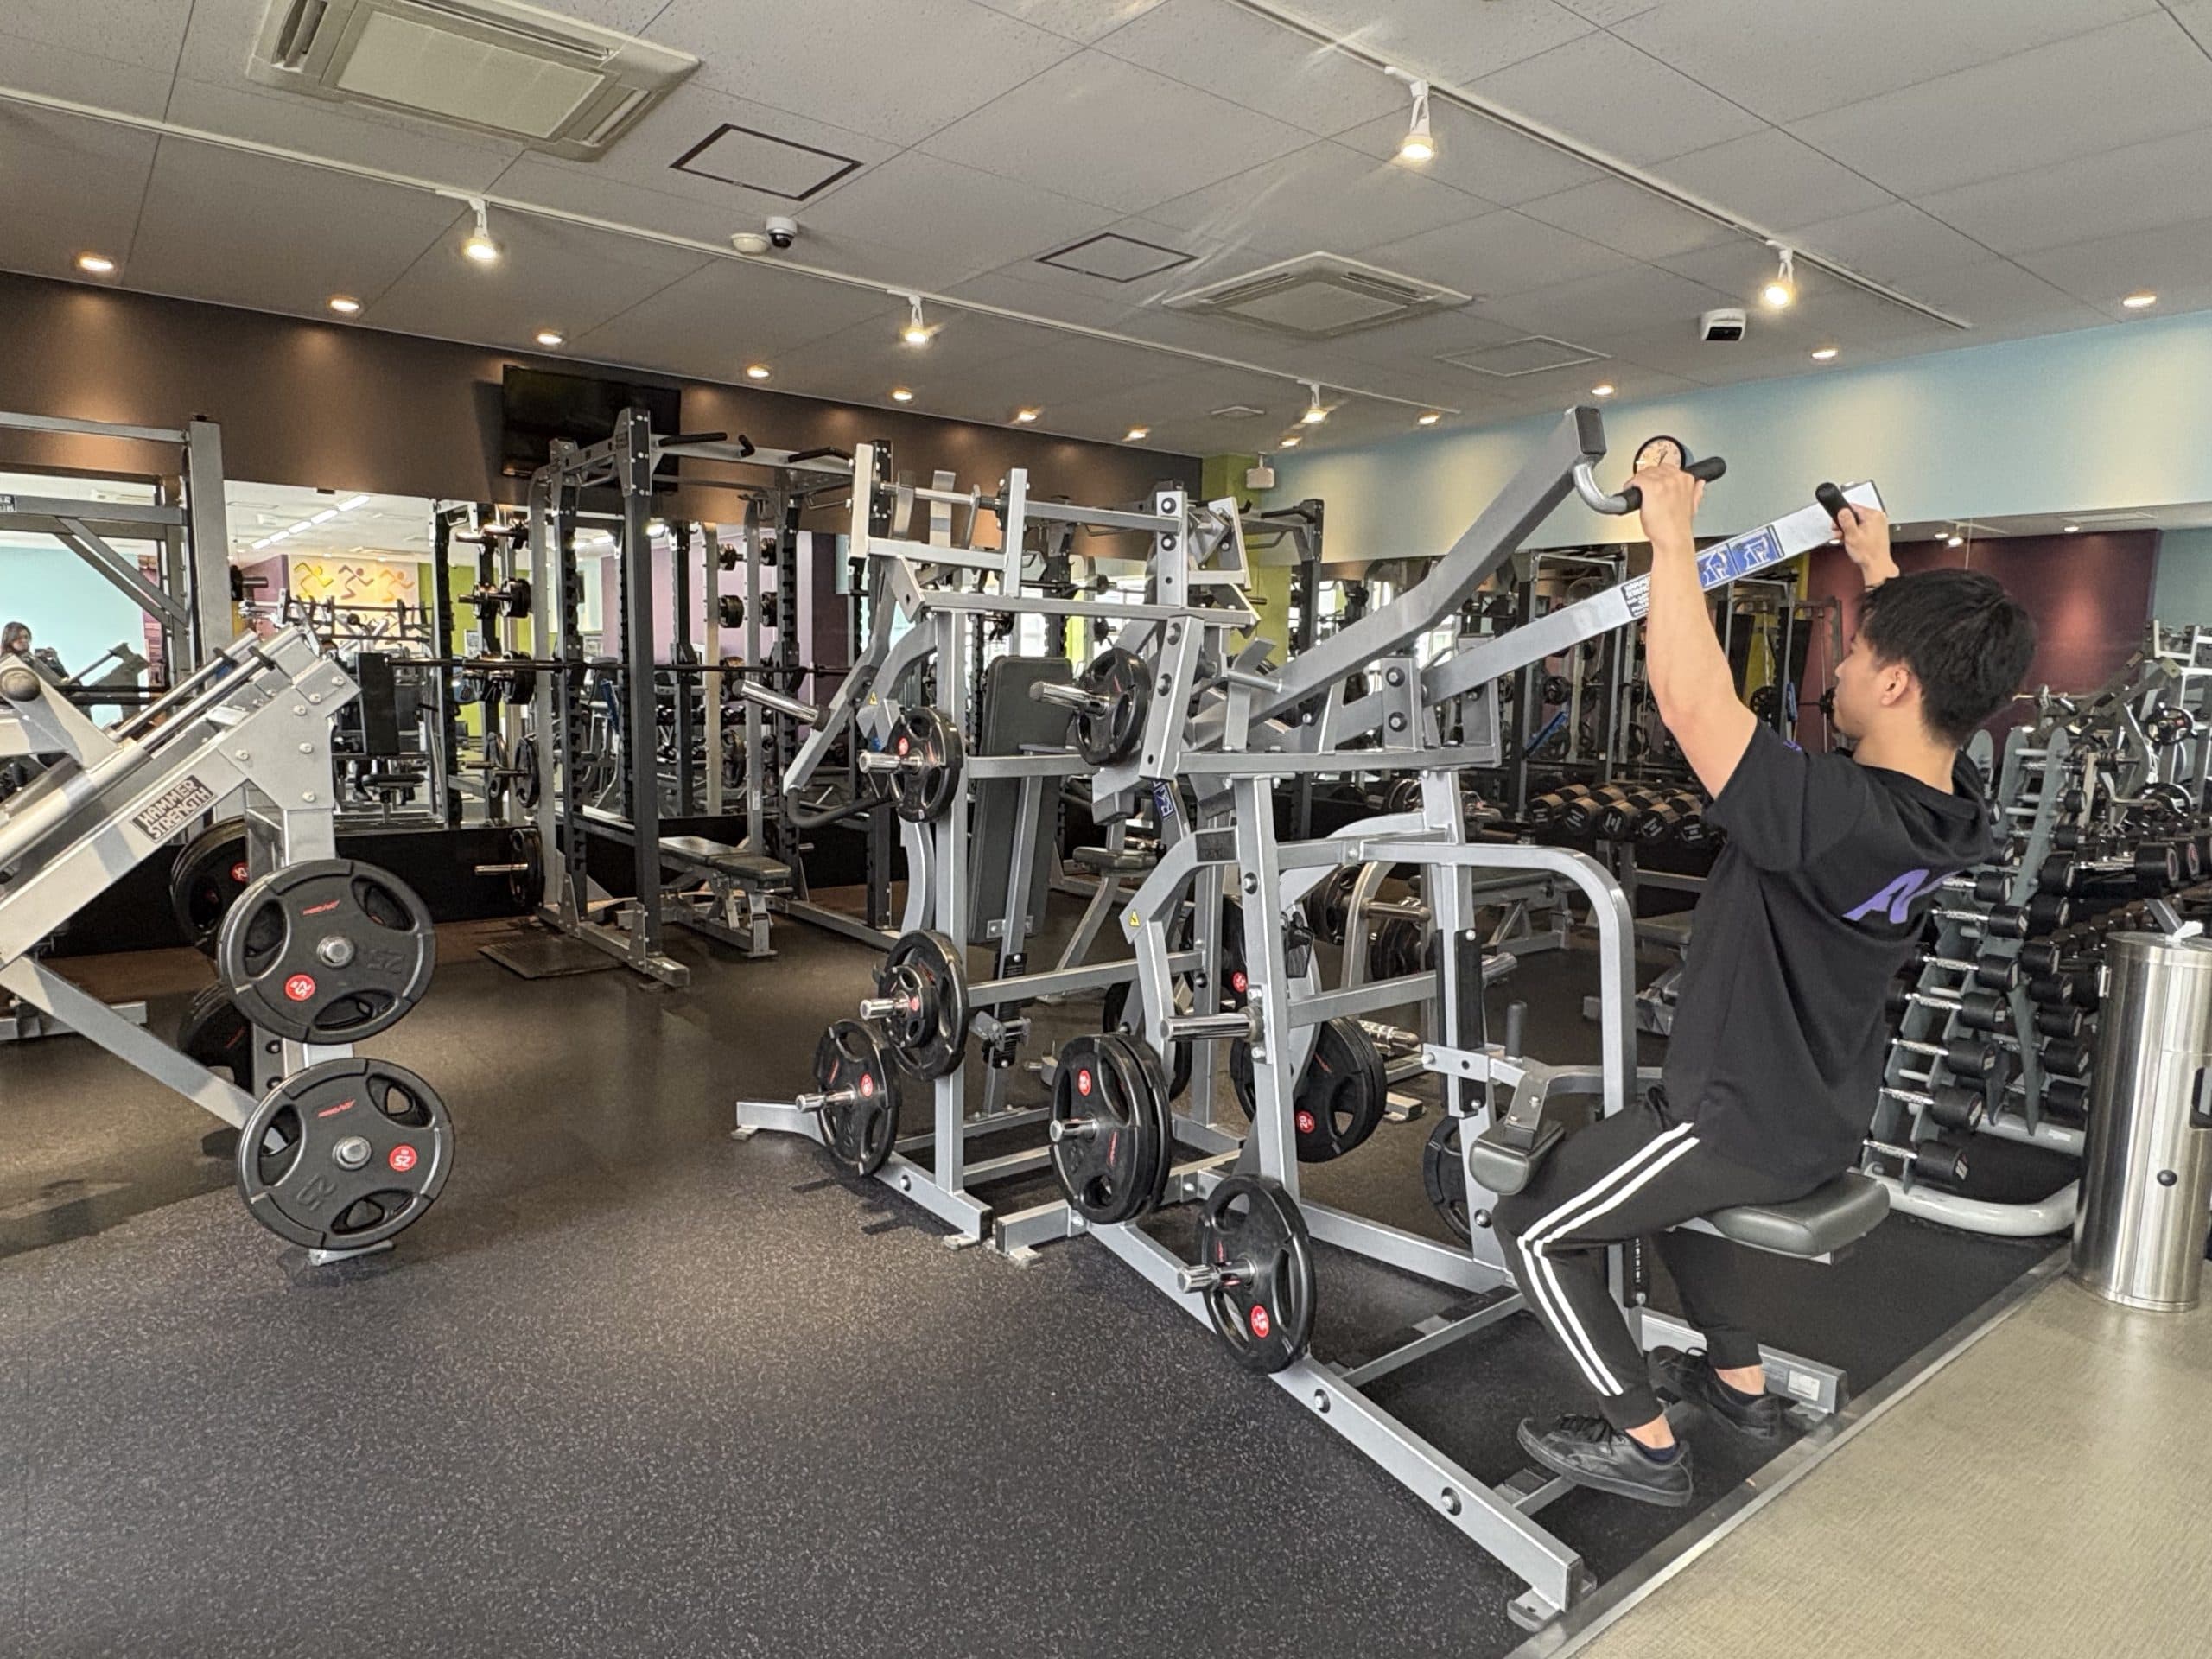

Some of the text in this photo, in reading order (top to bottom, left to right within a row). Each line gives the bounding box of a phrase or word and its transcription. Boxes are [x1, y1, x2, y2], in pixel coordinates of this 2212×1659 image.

[137, 779, 198, 826] HAMMER
[148, 785, 212, 838] STRENGTH
[295, 980, 312, 996] 25
[1299, 1115, 1307, 1128] 20
[394, 1154, 410, 1167] 25
